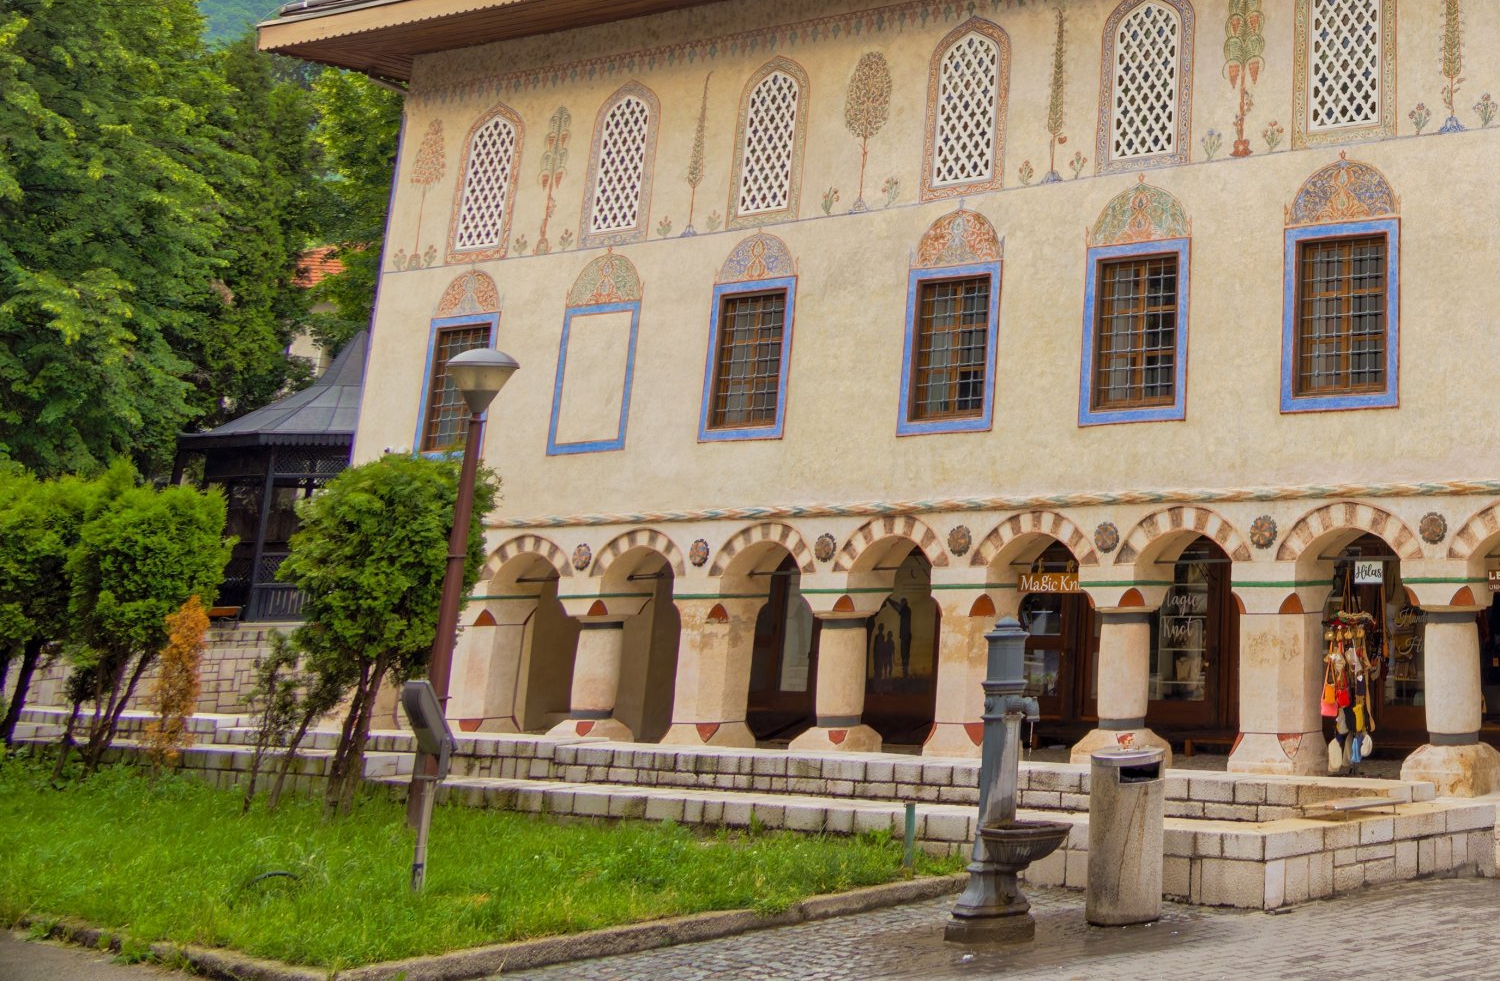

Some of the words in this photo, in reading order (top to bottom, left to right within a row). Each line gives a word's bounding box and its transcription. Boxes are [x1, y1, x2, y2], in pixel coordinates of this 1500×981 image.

[1356, 564, 1382, 579] Hilas
[1020, 575, 1058, 591] Magic
[1160, 616, 1200, 639] Knot
